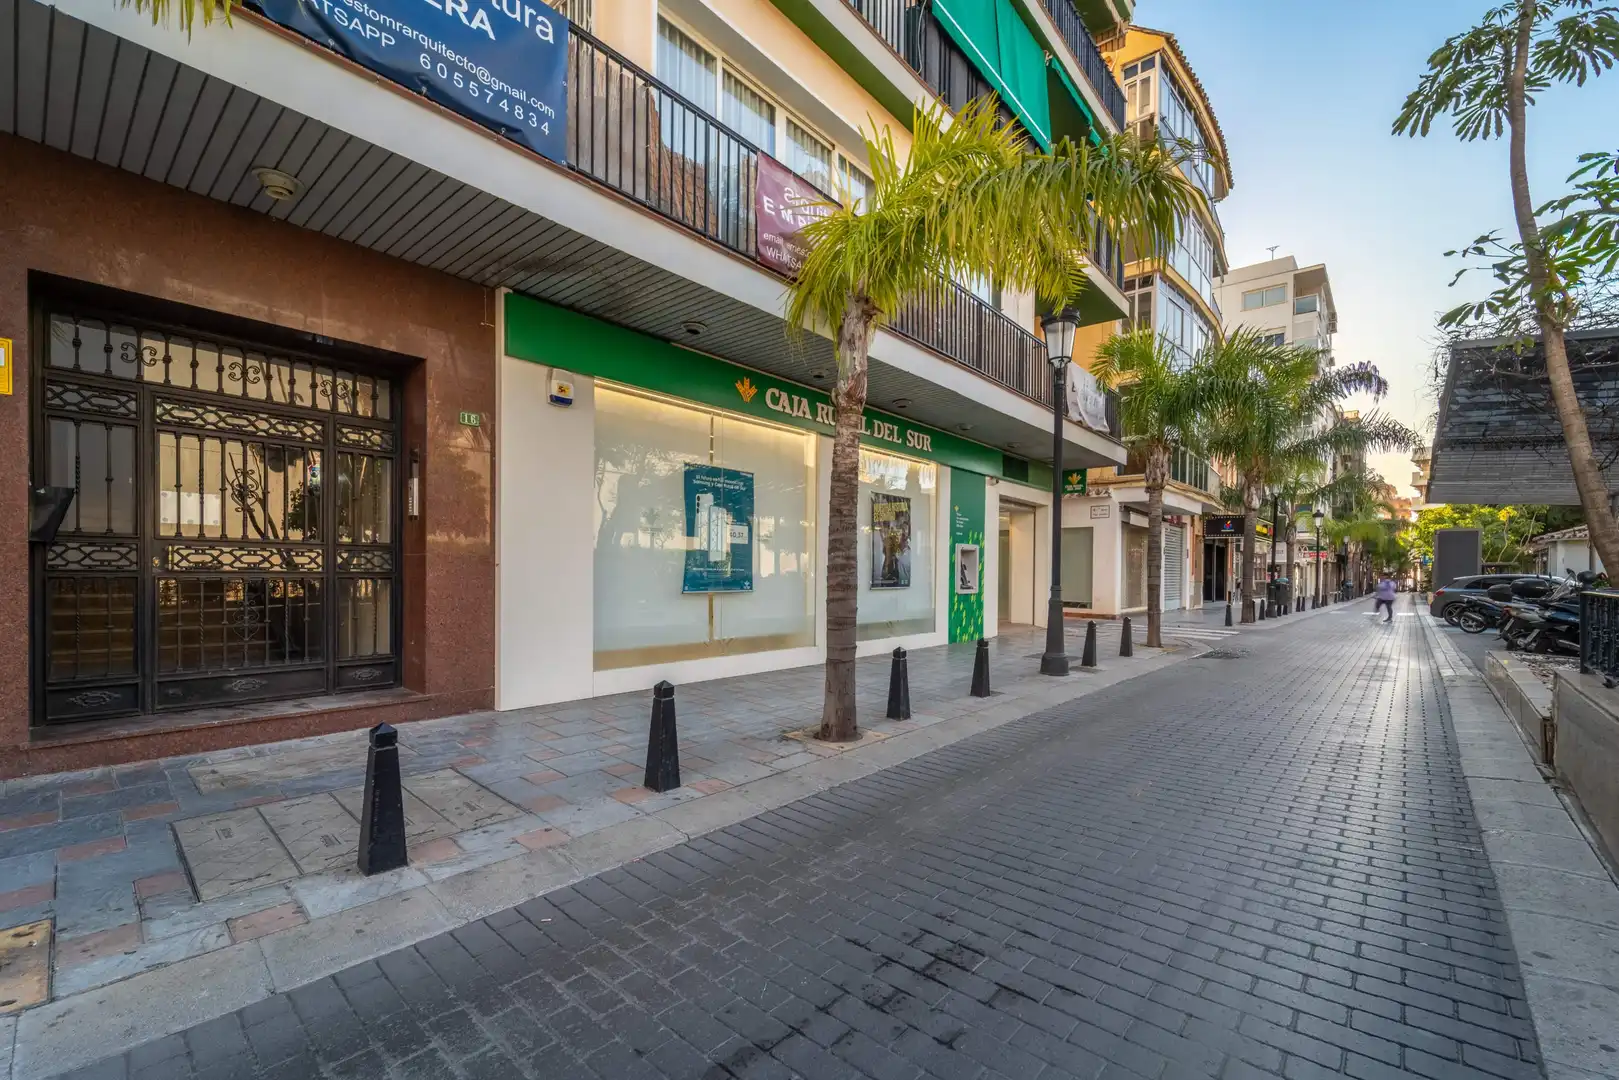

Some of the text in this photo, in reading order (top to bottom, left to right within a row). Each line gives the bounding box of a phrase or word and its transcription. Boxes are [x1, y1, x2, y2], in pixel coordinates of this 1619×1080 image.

[424, 0, 496, 41] RA
[464, 413, 476, 424] 16
[765, 388, 932, 452] CAJA RUL DEL SUR
